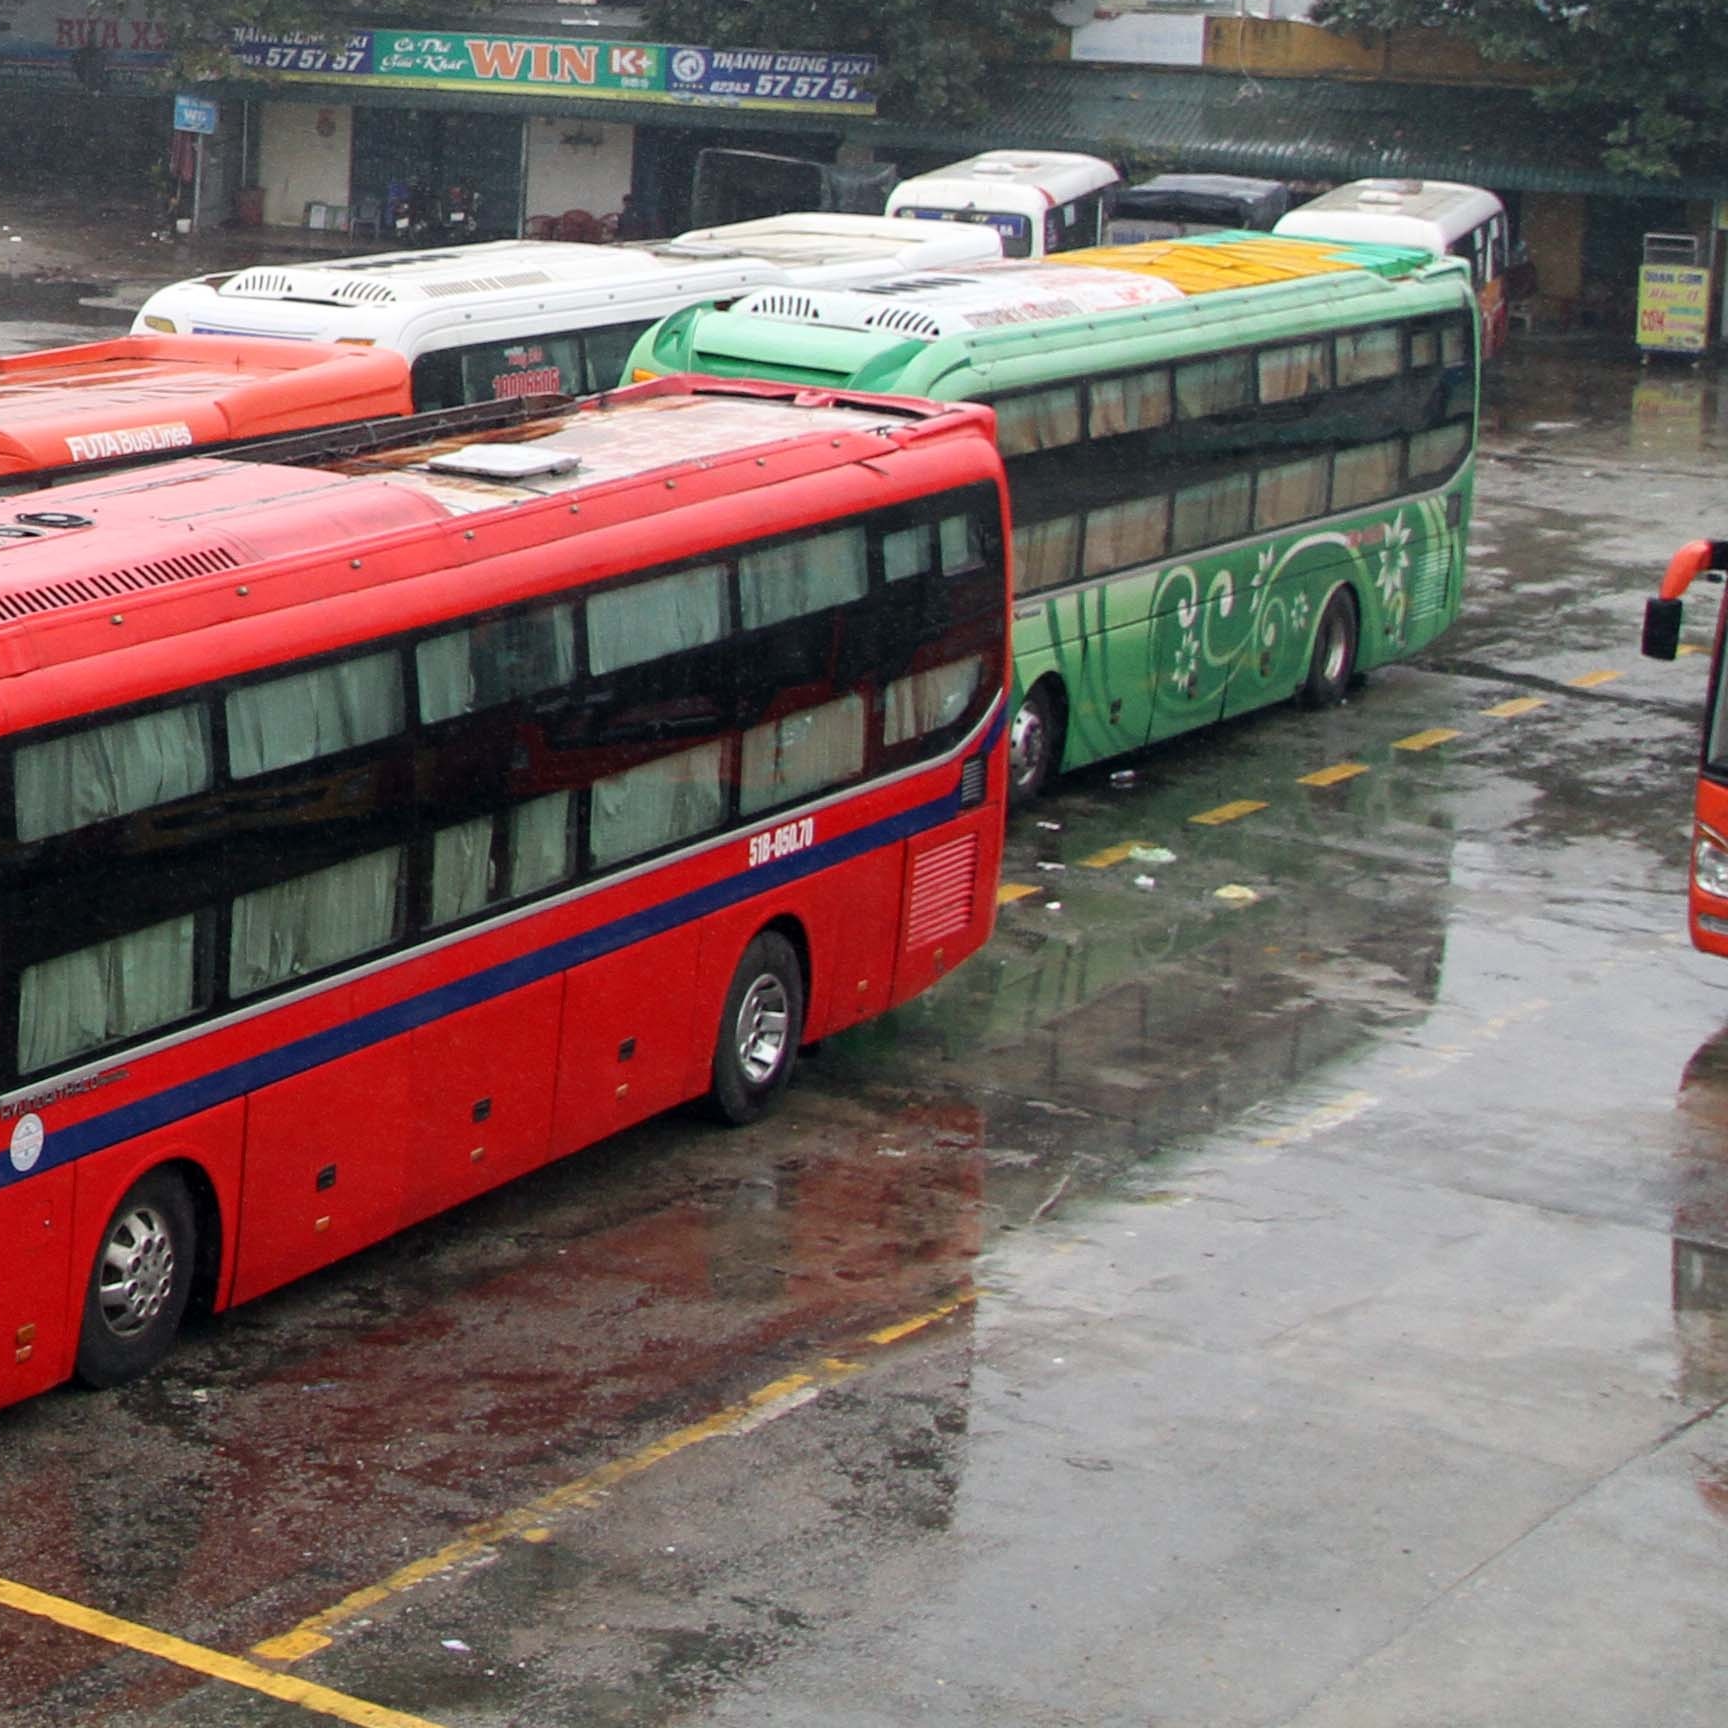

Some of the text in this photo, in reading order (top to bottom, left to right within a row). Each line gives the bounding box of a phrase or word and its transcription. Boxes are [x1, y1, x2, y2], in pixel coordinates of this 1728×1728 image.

[265, 48, 295, 68] 57
[464, 40, 600, 83] WIN
[755, 73, 784, 95] 57
[792, 75, 824, 98] 57
[63, 429, 122, 463] FUTA
[748, 817, 814, 867] 51B-050.70
